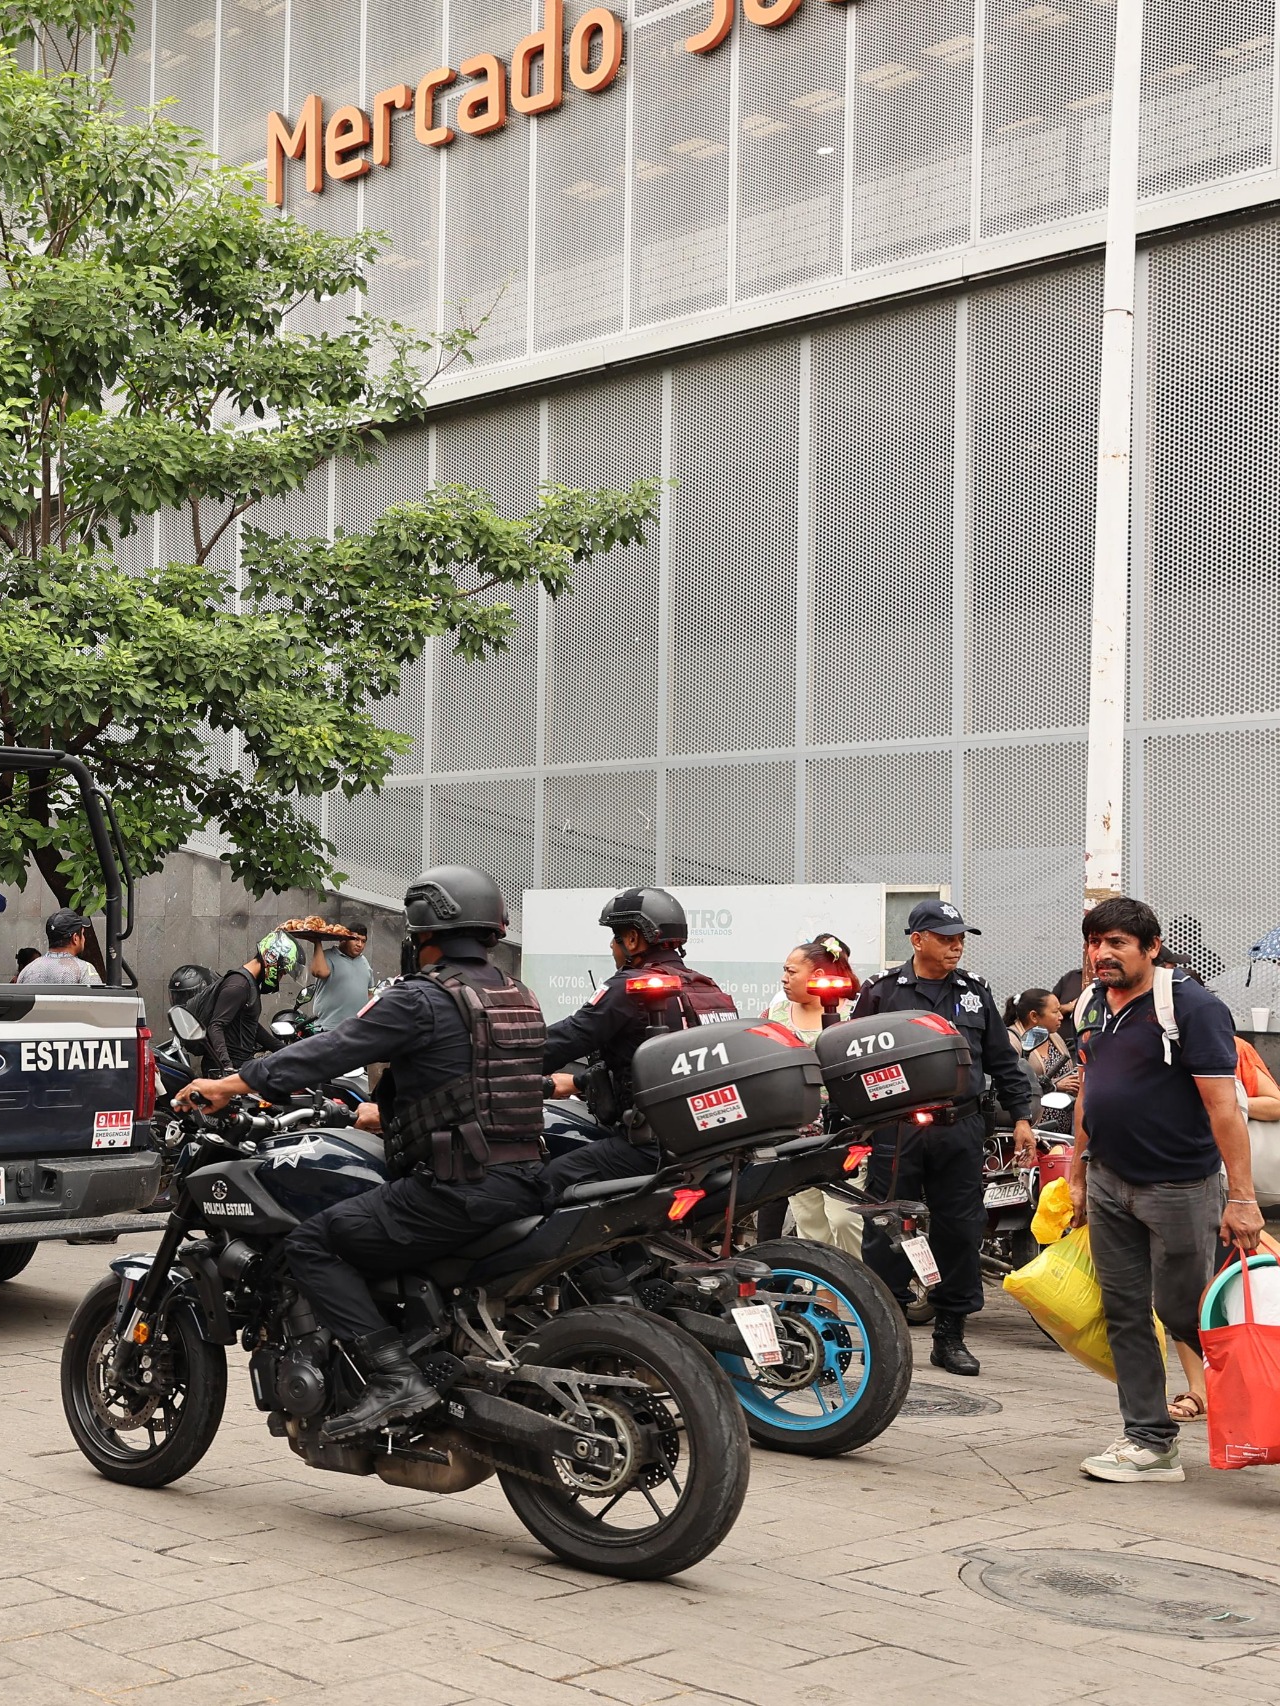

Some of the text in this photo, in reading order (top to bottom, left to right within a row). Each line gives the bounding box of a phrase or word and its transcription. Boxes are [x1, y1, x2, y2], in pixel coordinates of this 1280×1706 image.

[266, 0, 625, 207] Mercado
[685, 909, 733, 928] TRO
[719, 979, 738, 993] cio
[742, 982, 758, 993] en
[762, 981, 784, 997] pri
[558, 992, 588, 1005] dentr
[747, 998, 769, 1011] Pin
[846, 1031, 895, 1057] 470
[20, 1040, 129, 1072] ESTATAL
[671, 1042, 730, 1075] 471
[866, 1068, 898, 1084] 911
[868, 1080, 905, 1094] EMERGENCIAS
[693, 1089, 733, 1109] 911
[98, 1113, 128, 1127] 911
[696, 1105, 741, 1121] EMERGENCIAS
[203, 1201, 255, 1216] POLICIA ESTATAL
